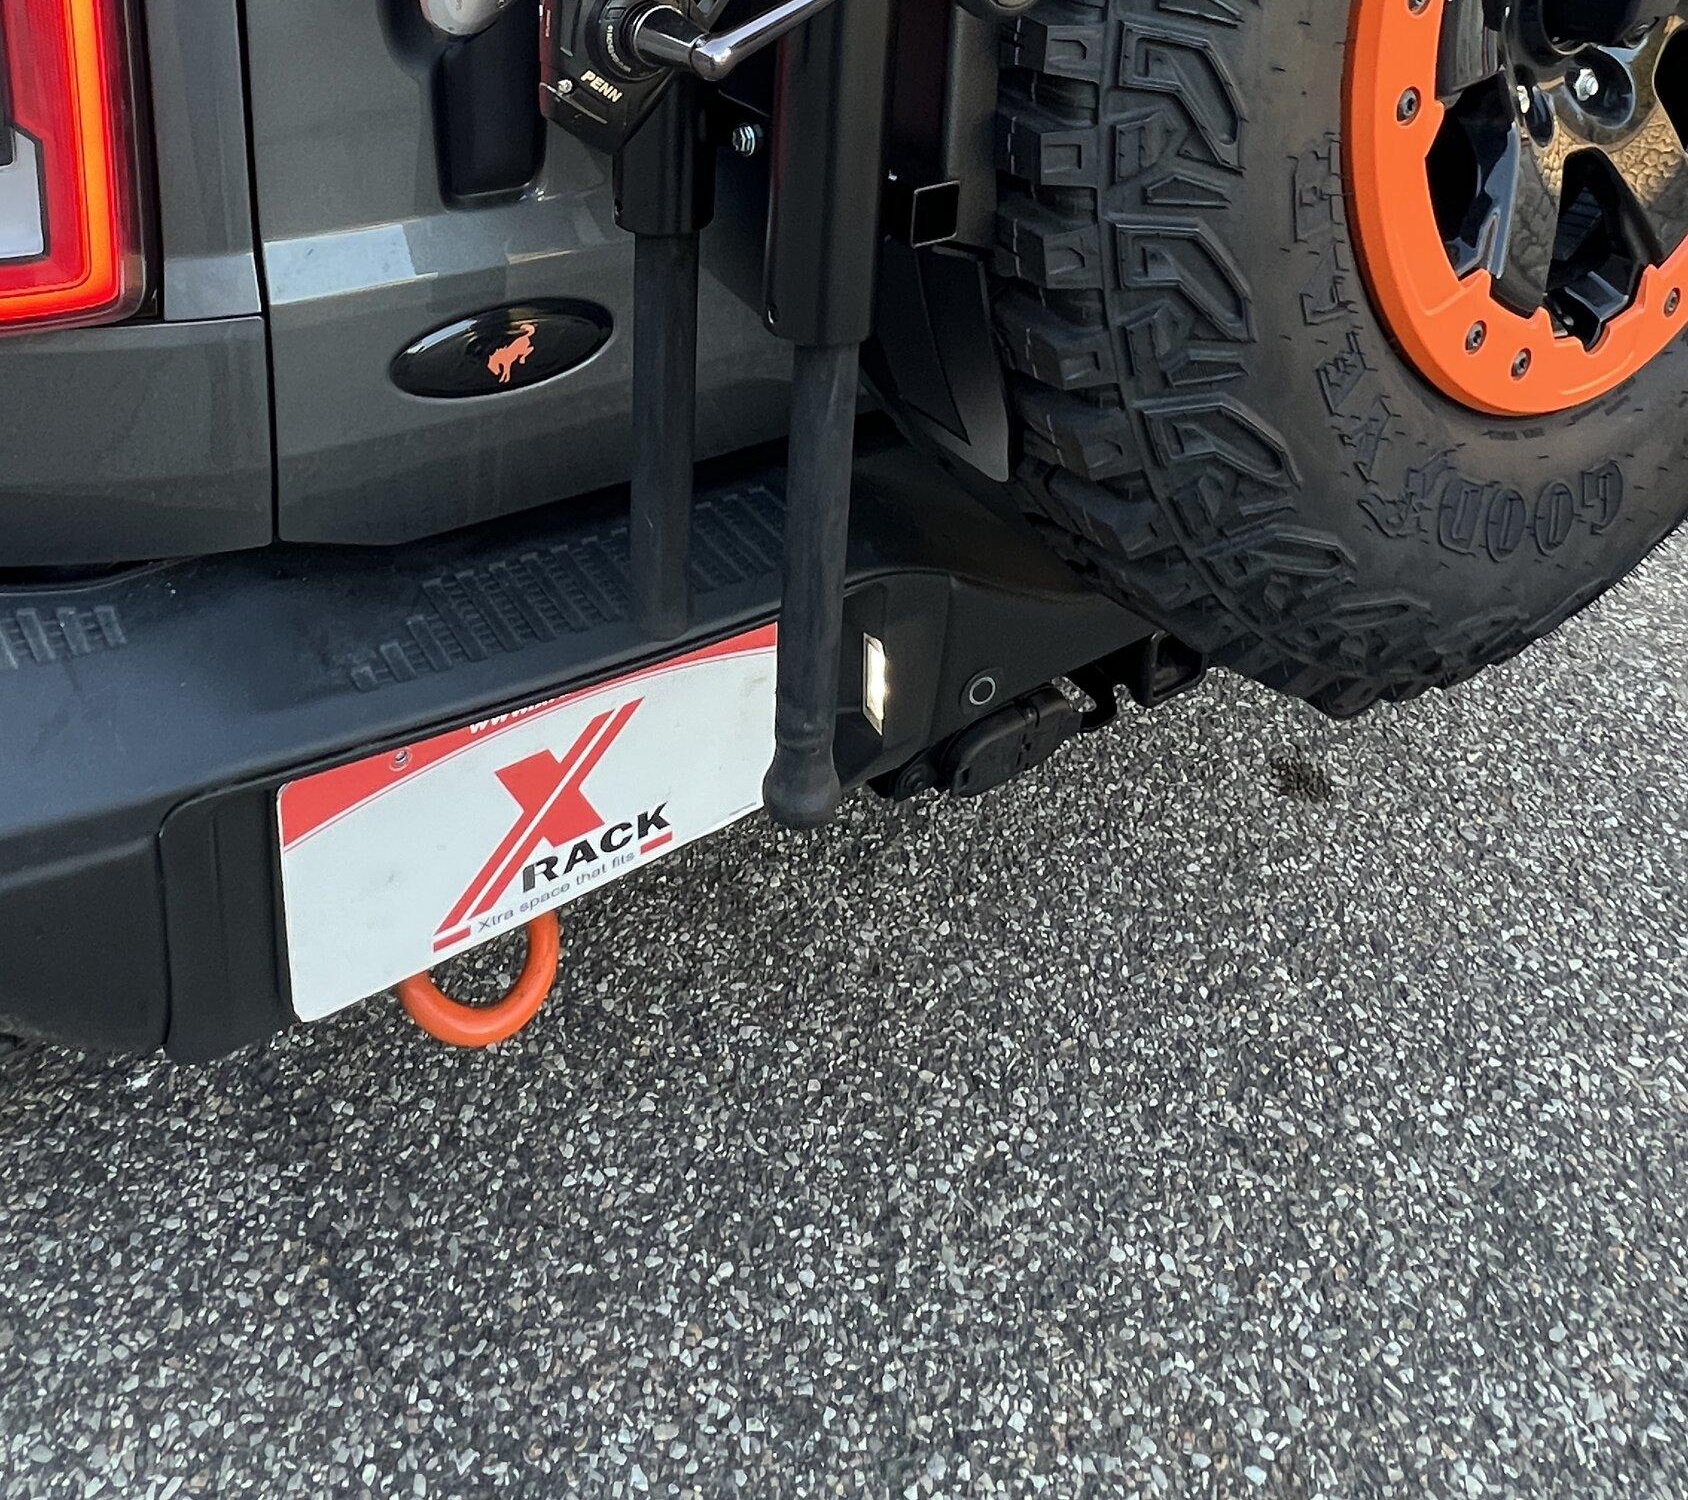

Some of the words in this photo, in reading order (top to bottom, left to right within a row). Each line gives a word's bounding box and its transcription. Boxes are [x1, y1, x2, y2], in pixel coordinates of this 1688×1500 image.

[580, 69, 623, 103] PENN
[522, 801, 671, 894] RACK
[477, 908, 514, 934] Xtra
[519, 882, 571, 918] space
[575, 863, 608, 887] that
[612, 851, 636, 868] fits
